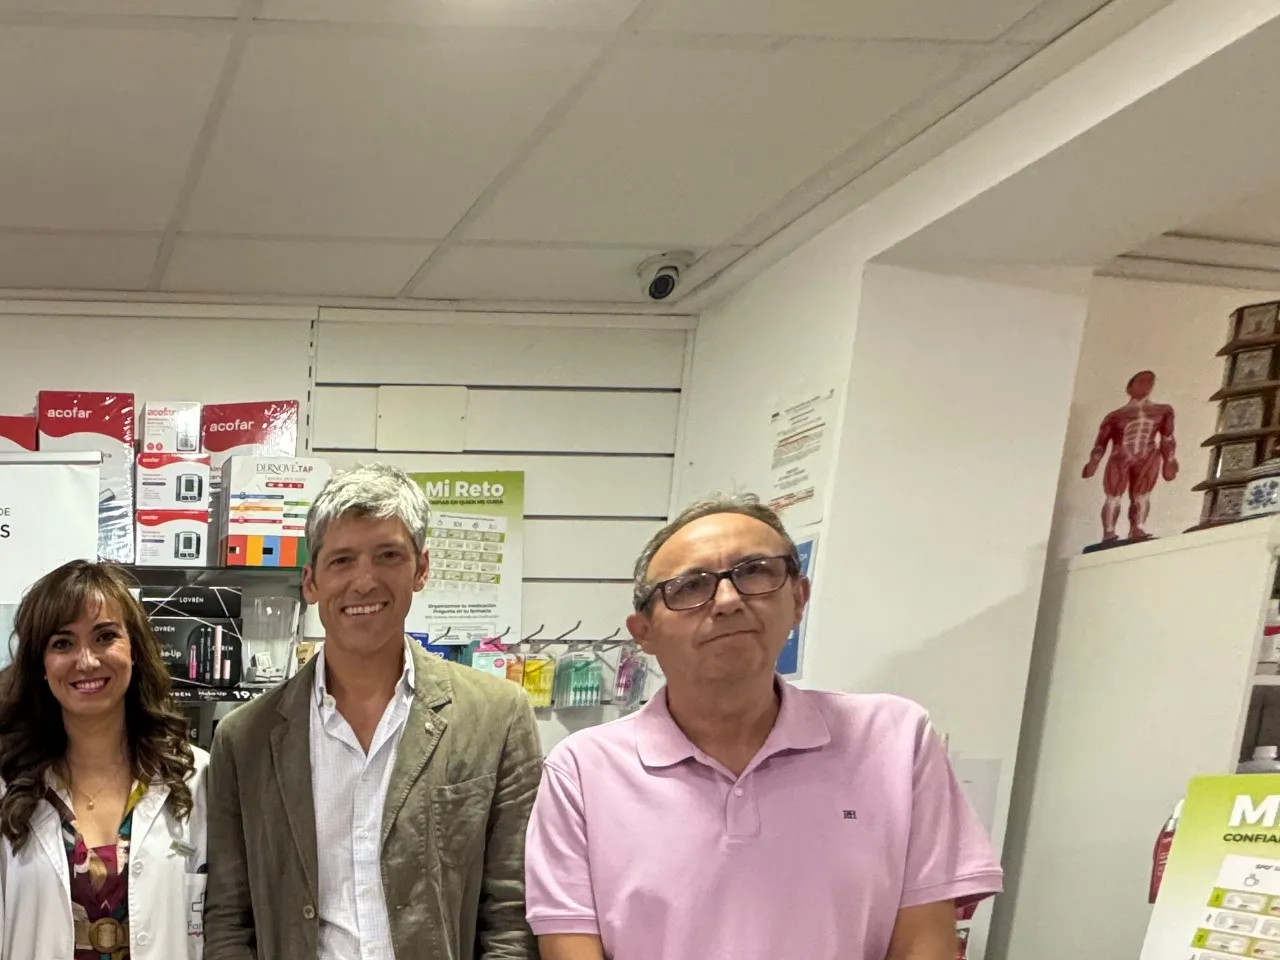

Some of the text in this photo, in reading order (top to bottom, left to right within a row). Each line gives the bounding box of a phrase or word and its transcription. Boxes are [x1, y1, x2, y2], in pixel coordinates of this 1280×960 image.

[47, 407, 93, 419] acofar
[147, 407, 177, 416] acofar
[209, 419, 255, 432] acofar
[426, 479, 504, 497] Mi Reto
[1227, 794, 1280, 827] M
[1223, 833, 1280, 843] CONFIA
